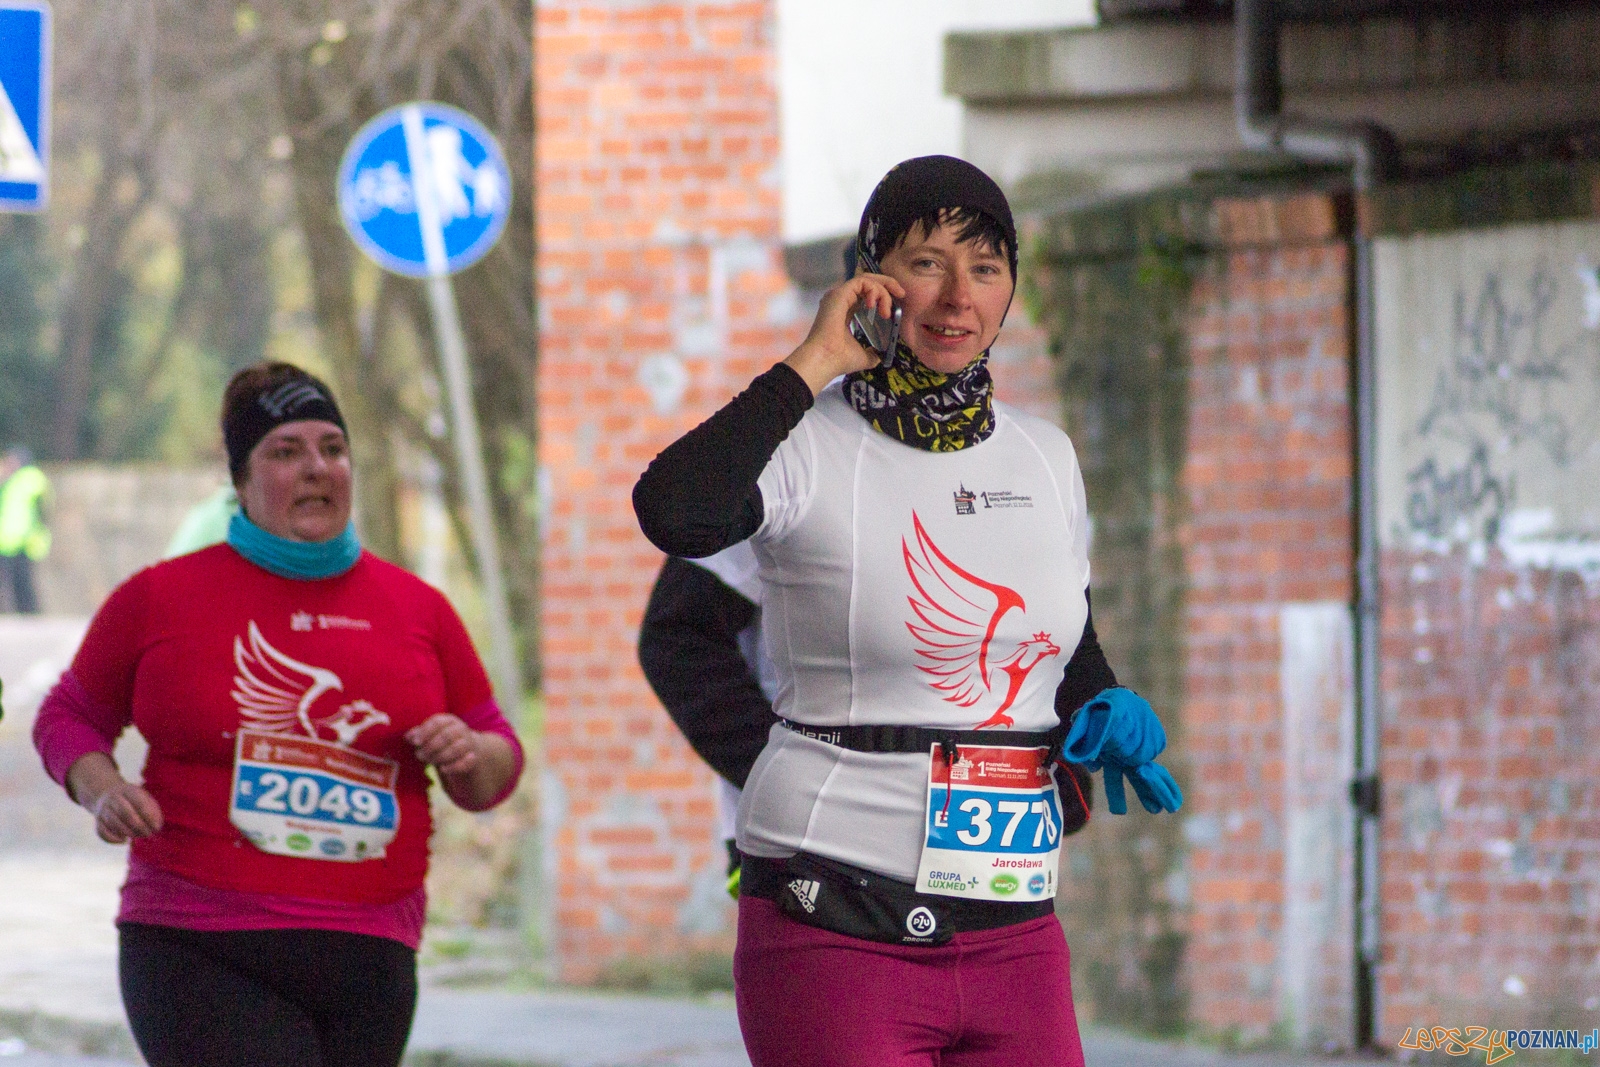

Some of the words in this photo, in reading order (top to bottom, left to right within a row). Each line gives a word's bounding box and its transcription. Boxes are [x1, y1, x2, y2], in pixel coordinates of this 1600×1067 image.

[977, 760, 987, 777] 1
[255, 771, 381, 824] 2049
[956, 798, 1057, 847] 3778
[992, 857, 1043, 869] Jarosława
[929, 870, 961, 882] GRUPA
[927, 879, 966, 891] LUXMED
[913, 915, 930, 929] PZU
